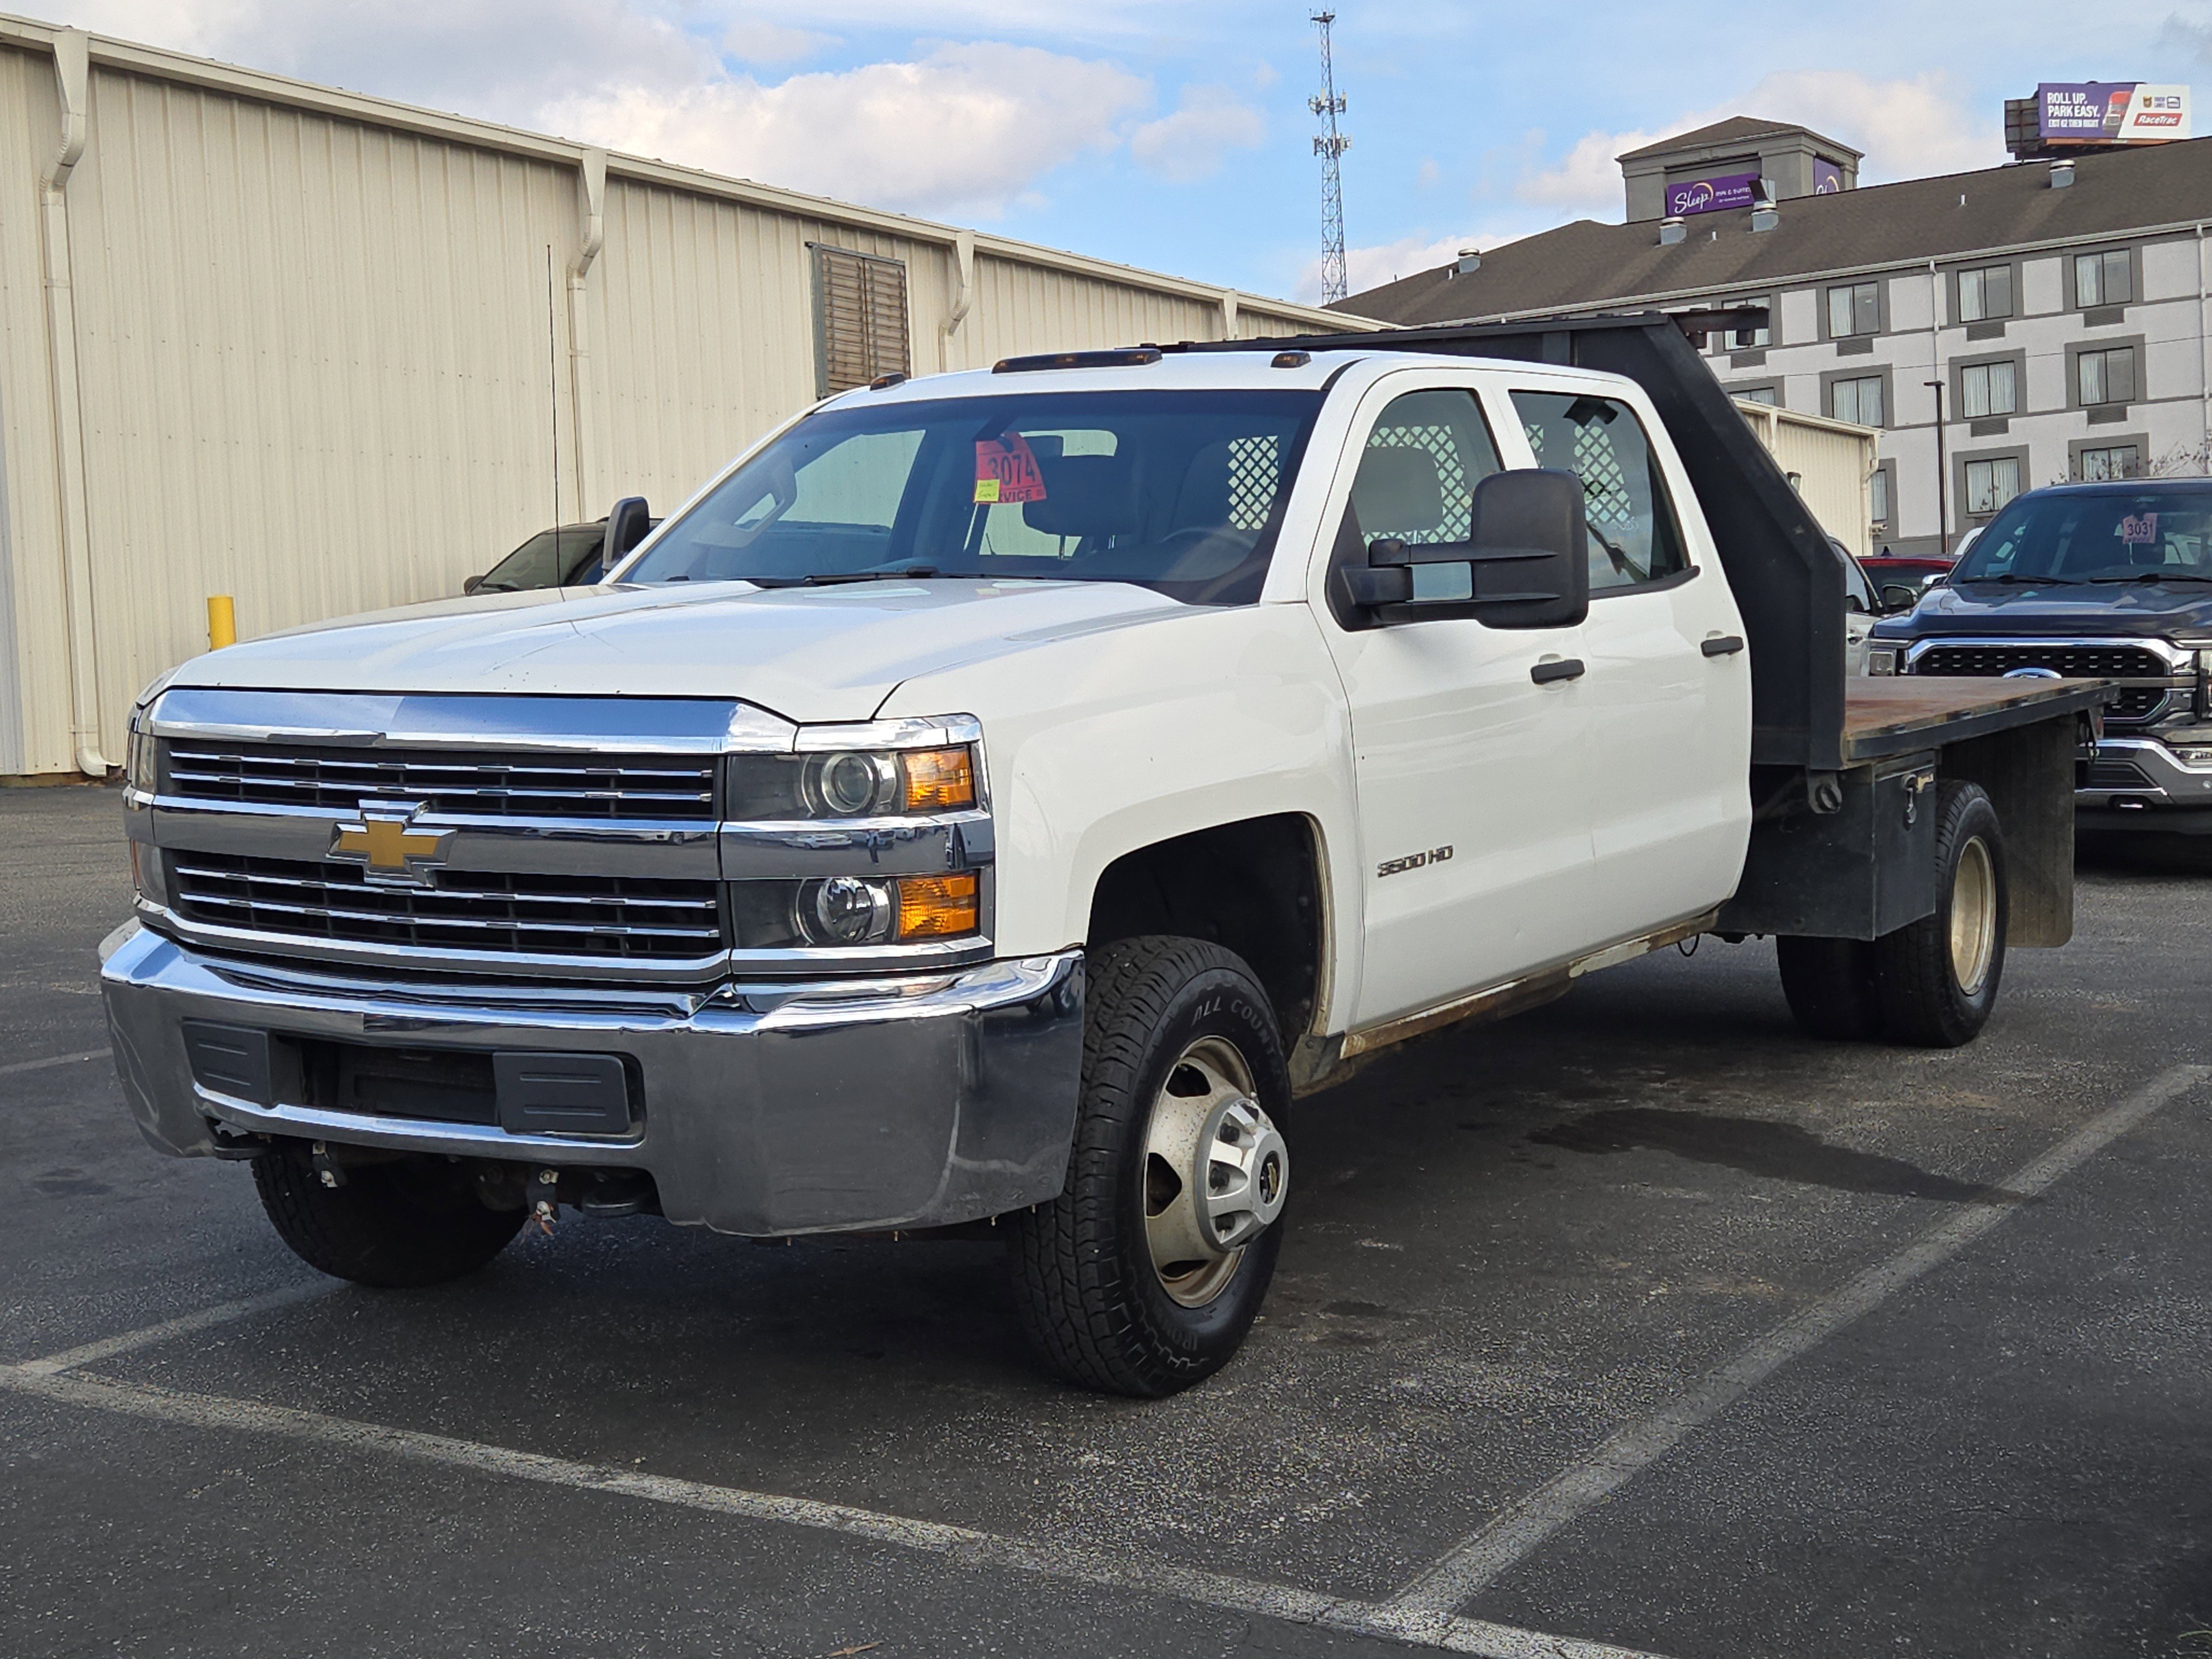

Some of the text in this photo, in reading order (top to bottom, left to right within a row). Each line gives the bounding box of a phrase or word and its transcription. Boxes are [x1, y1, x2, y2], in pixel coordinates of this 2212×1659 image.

[2047, 92, 2088, 105] ROLL UP.
[2048, 105, 2100, 118] PARK EASY.
[2138, 115, 2178, 125] RaceTrac
[1674, 190, 1709, 214] Sleep
[987, 453, 1035, 485] 3074
[2128, 522, 2153, 536] 3031
[1191, 996, 1221, 1027] ALL
